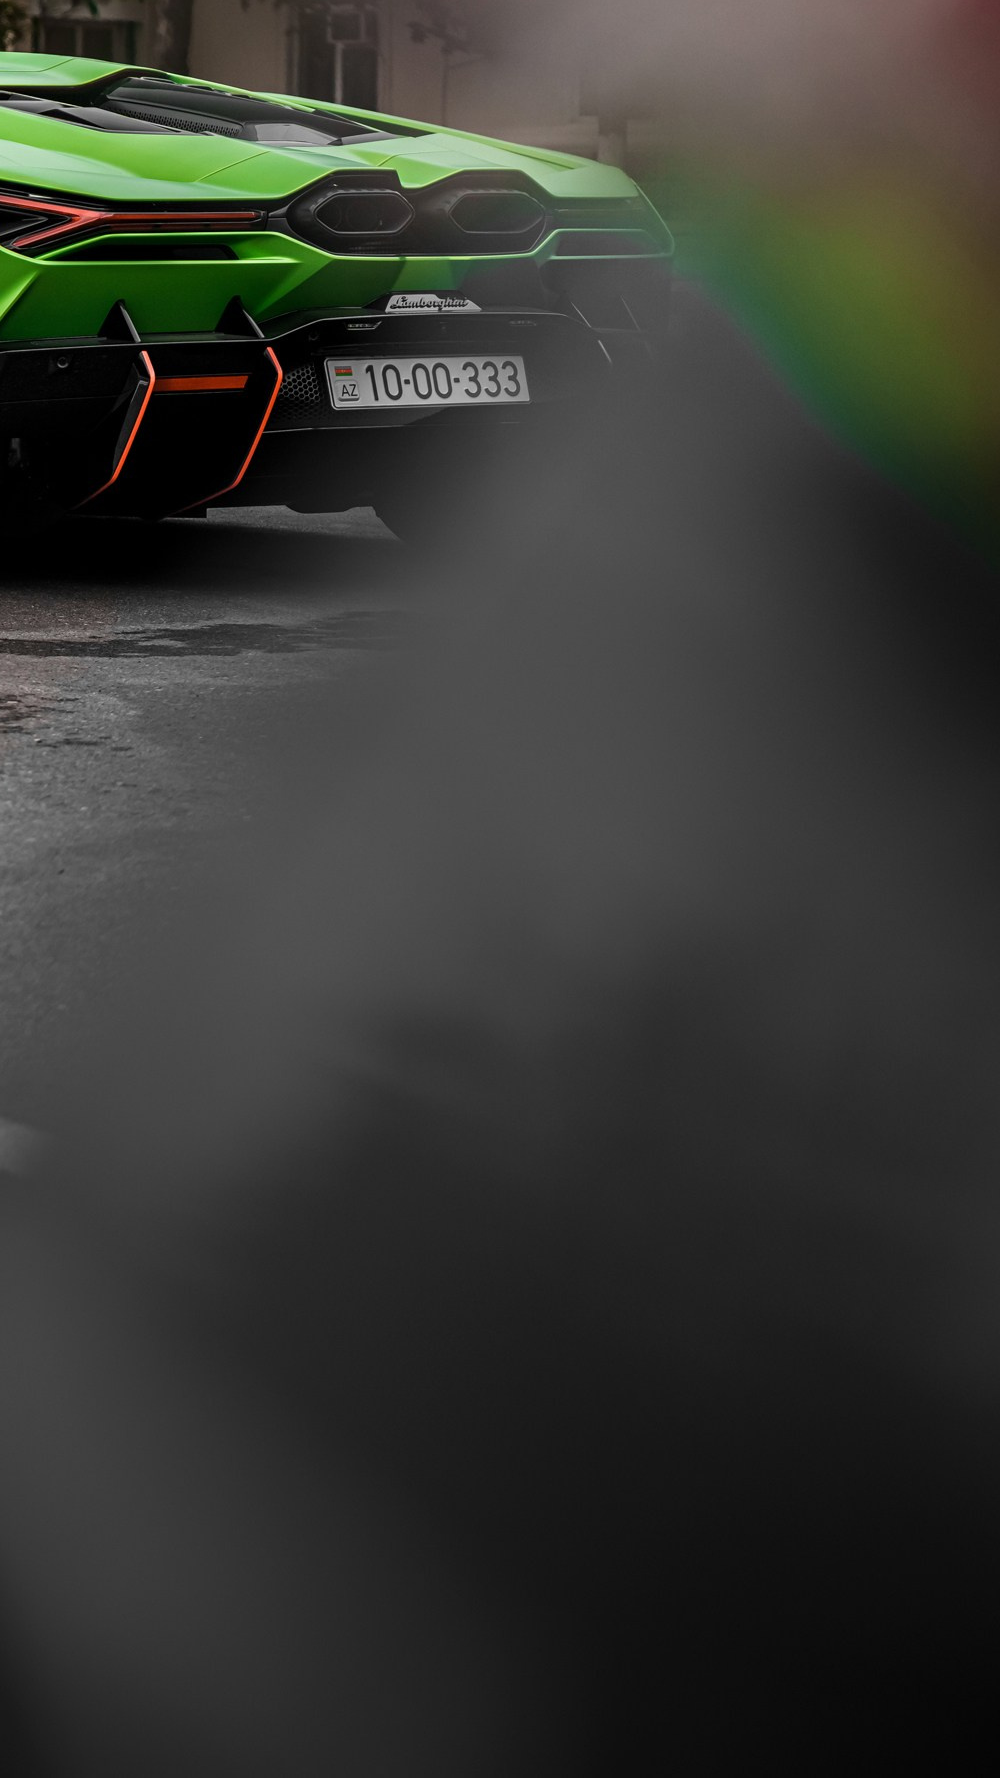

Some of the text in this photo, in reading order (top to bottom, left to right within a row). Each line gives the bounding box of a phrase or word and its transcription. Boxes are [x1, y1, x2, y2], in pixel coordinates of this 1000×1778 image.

[390, 296, 468, 311] Lamborghini
[365, 361, 520, 401] 10-00-333
[341, 384, 358, 397] AZ
